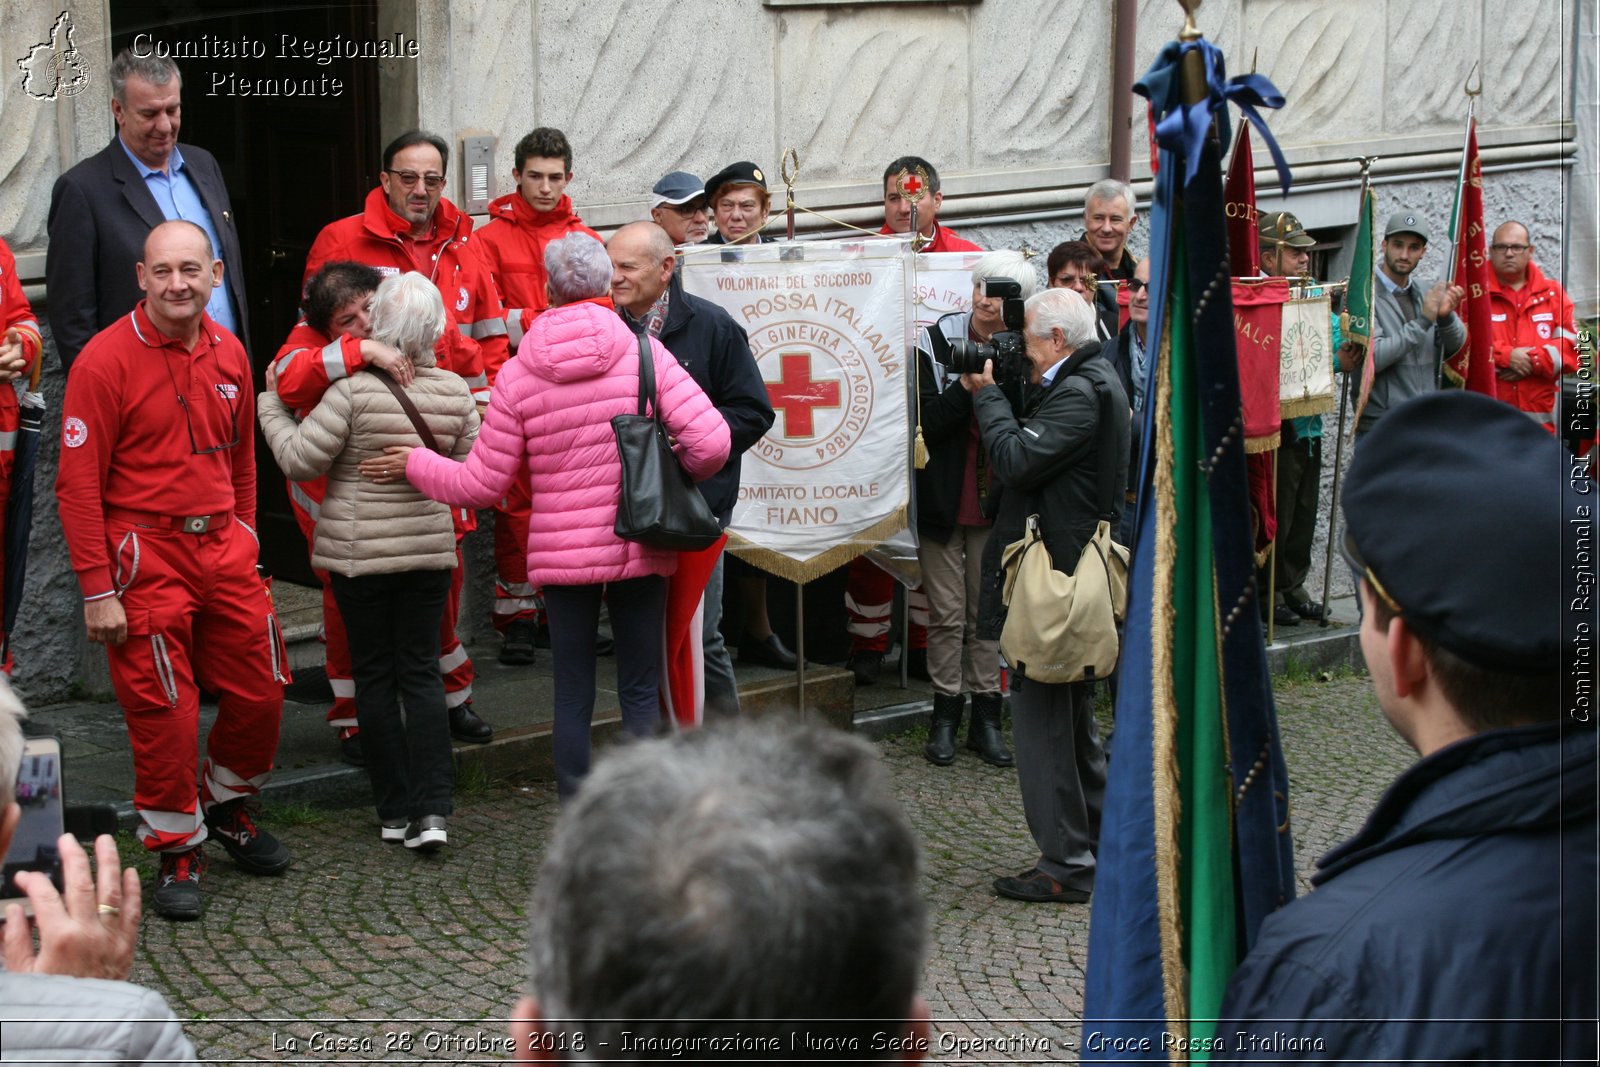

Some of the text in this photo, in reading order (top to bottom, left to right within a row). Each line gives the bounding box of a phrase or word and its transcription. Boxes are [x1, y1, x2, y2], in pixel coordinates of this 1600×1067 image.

[716, 272, 872, 291] VOLONTARI DEL SOCCORSO
[913, 286, 970, 312] SSA ITAL
[1233, 312, 1275, 351] NALE
[1350, 315, 1366, 329] PO
[740, 293, 900, 379] ROSSA ITALIANA
[767, 325, 841, 351] GINEVRA
[1281, 320, 1306, 370] GRUPPO
[841, 350, 861, 368] 22
[1280, 370, 1297, 386] IONE
[846, 373, 869, 432] AGOSTO
[755, 439, 784, 462] CON
[815, 431, 851, 460] 1864
[737, 482, 880, 501] OMITATO LOCALE
[766, 506, 839, 526] FIANO
